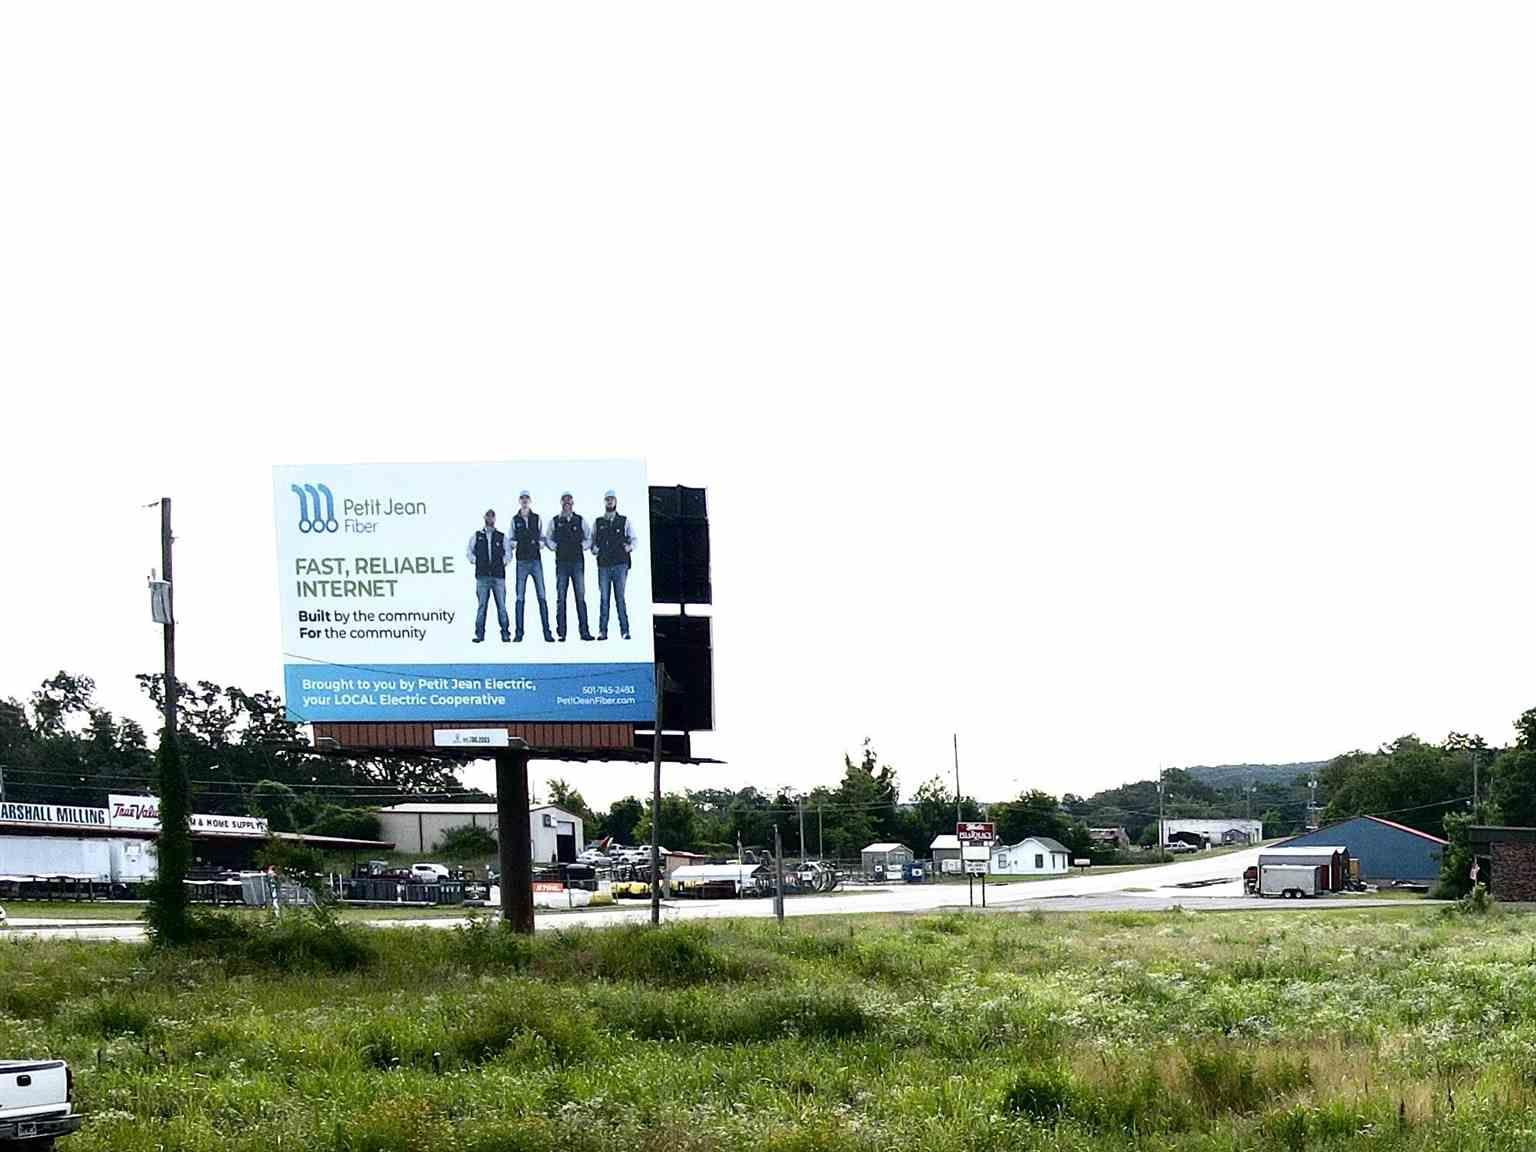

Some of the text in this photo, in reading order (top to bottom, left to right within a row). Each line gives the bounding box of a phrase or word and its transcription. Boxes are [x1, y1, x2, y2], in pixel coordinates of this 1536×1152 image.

[343, 498, 427, 516] Petit Jean
[344, 518, 378, 533] Fiber
[295, 556, 455, 578] FAST, RELIABLE
[296, 580, 398, 598] INTERNET
[298, 609, 455, 625] Built by the community
[299, 626, 427, 641] For the community
[302, 677, 537, 693] Brought to you by Petit Jean Electric,
[303, 693, 506, 708] your LOCAL Electric Cooperative
[0, 803, 106, 824] ARSHALL MILLING
[113, 803, 161, 819] True Valu
[206, 819, 229, 828] HOME
